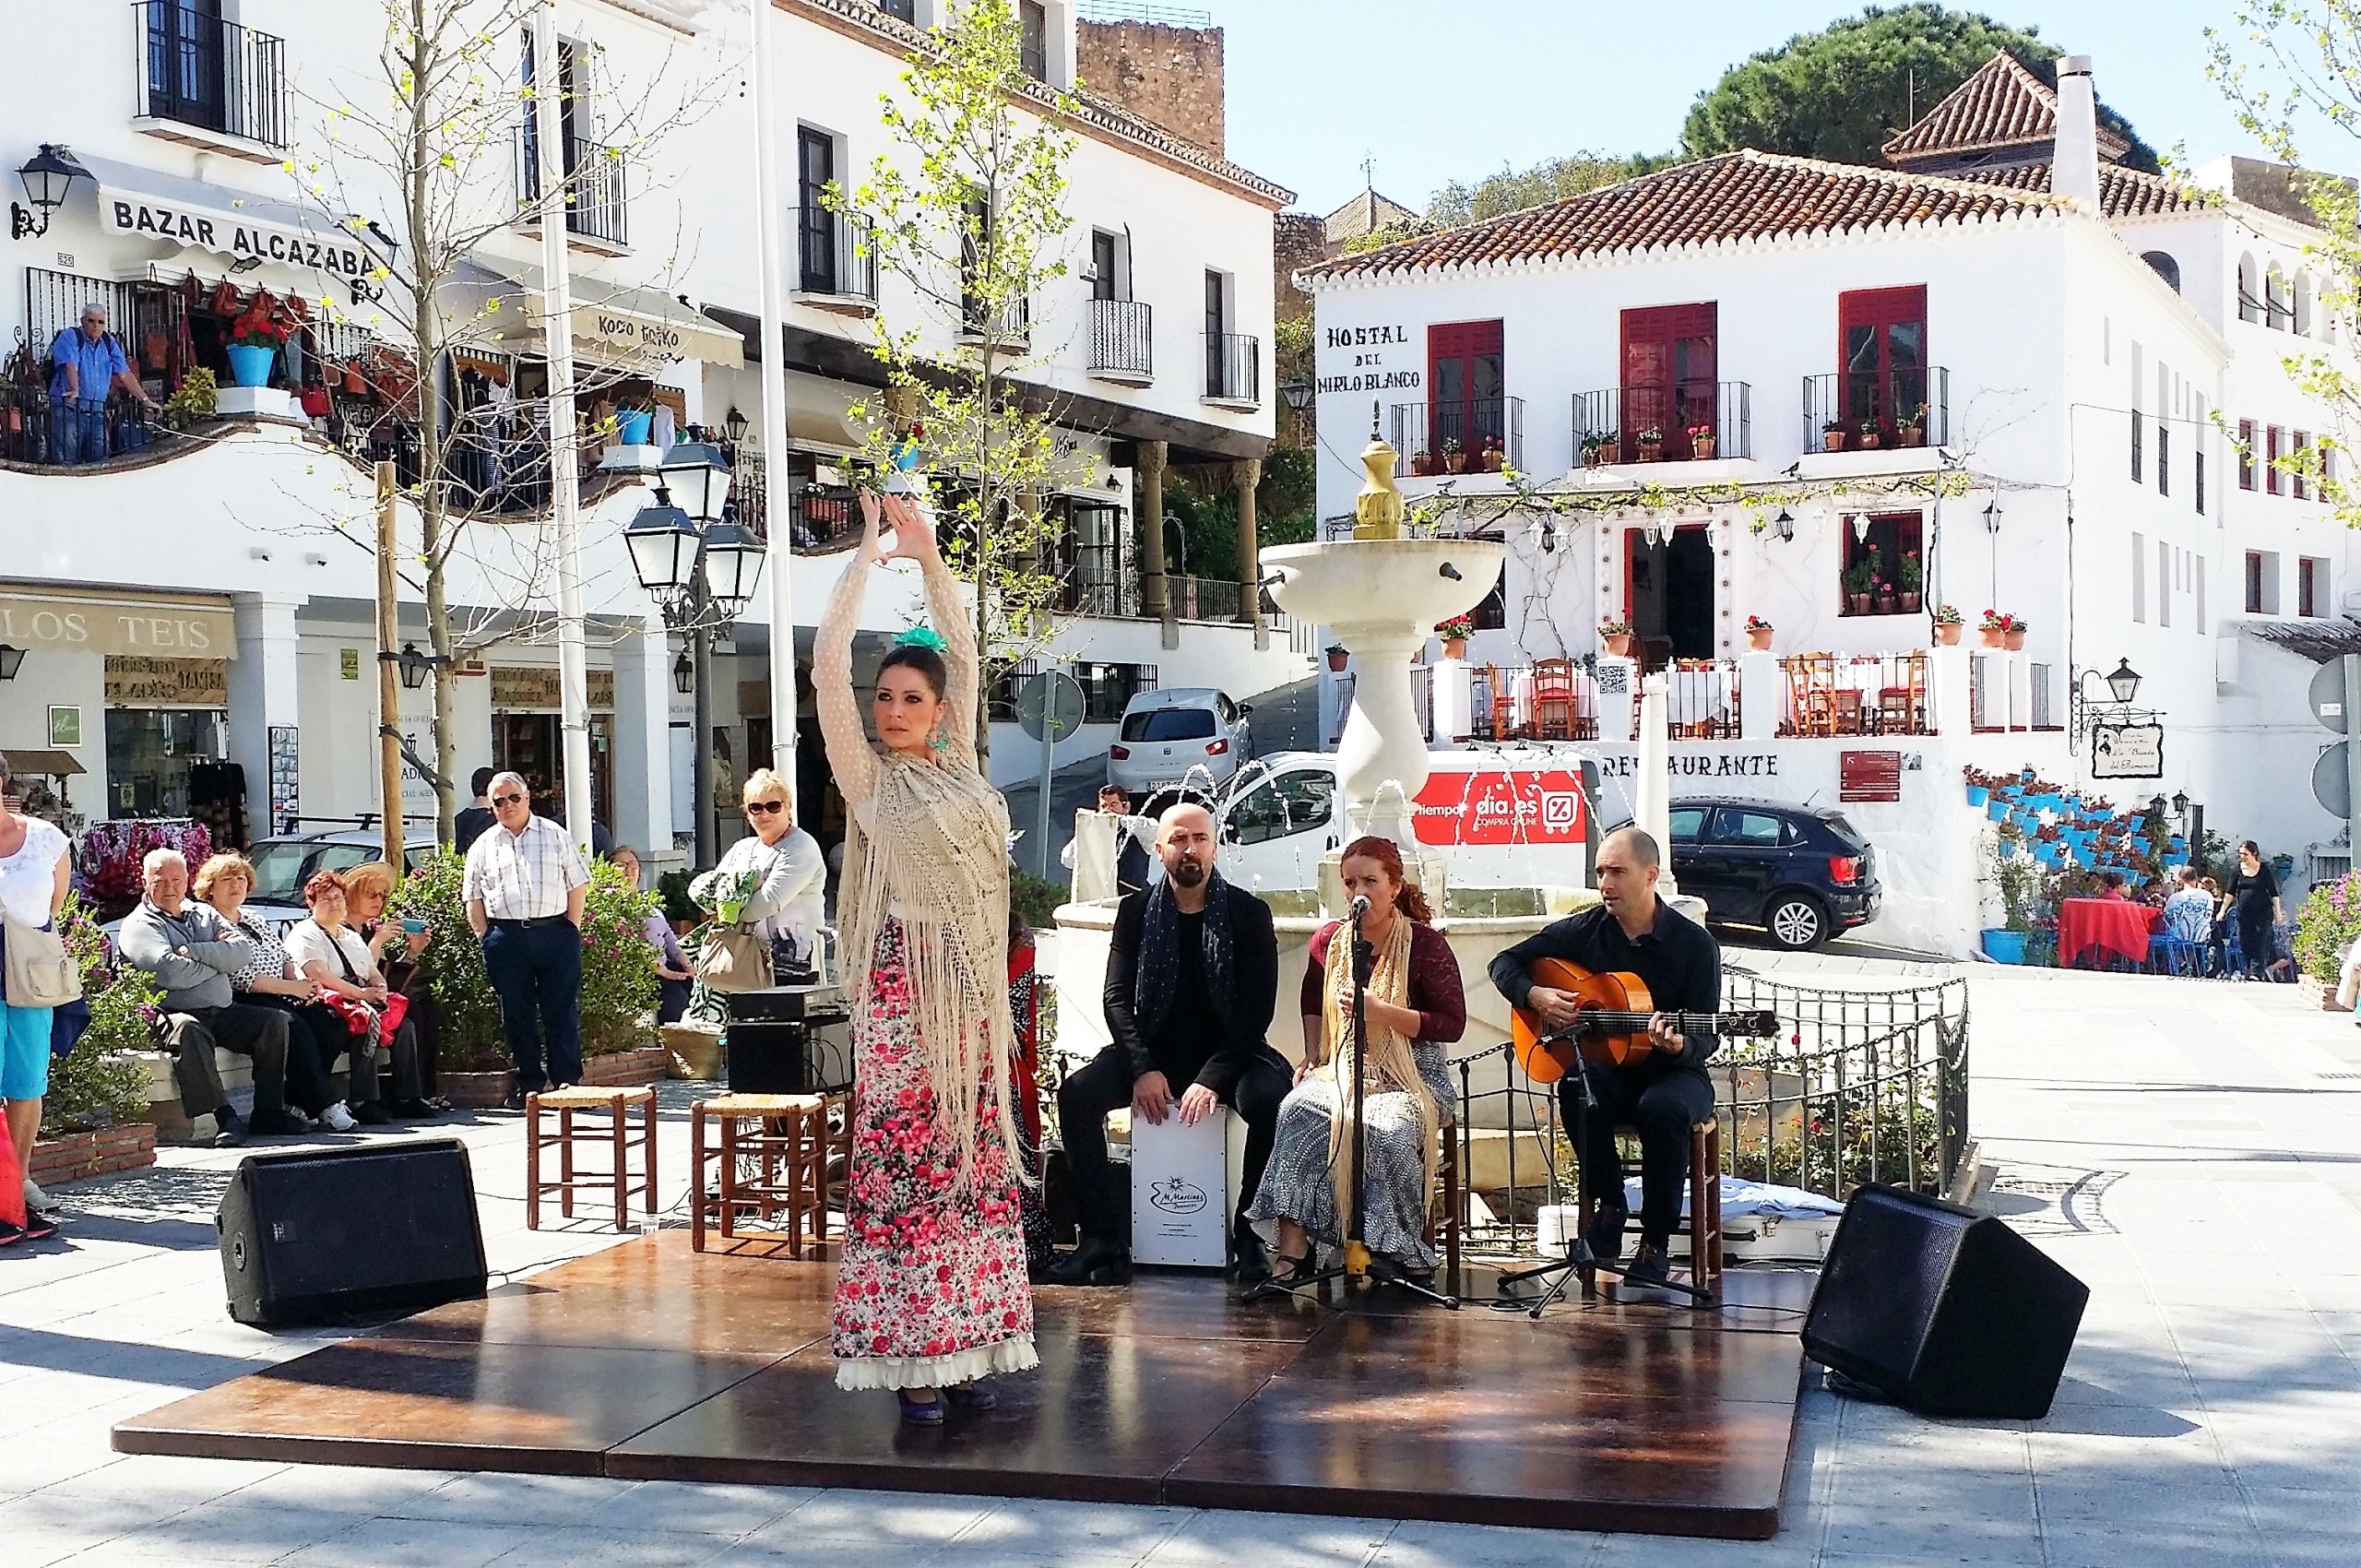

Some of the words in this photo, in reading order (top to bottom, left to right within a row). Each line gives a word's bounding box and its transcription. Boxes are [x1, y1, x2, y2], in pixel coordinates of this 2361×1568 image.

[113, 201, 216, 246] BAZAR
[233, 227, 376, 276] ALCAZABA
[1327, 325, 1408, 349] HOSTAL
[1354, 352, 1382, 367] DEL
[1317, 375, 1362, 394] MIRLO
[1364, 371, 1420, 391] BLANCO
[1, 609, 89, 643] LOS
[118, 616, 211, 648] TEIS
[1603, 754, 1778, 777] REAURANTE
[1476, 794, 1538, 816] dia.es
[1477, 817, 1509, 826] COMPRA
